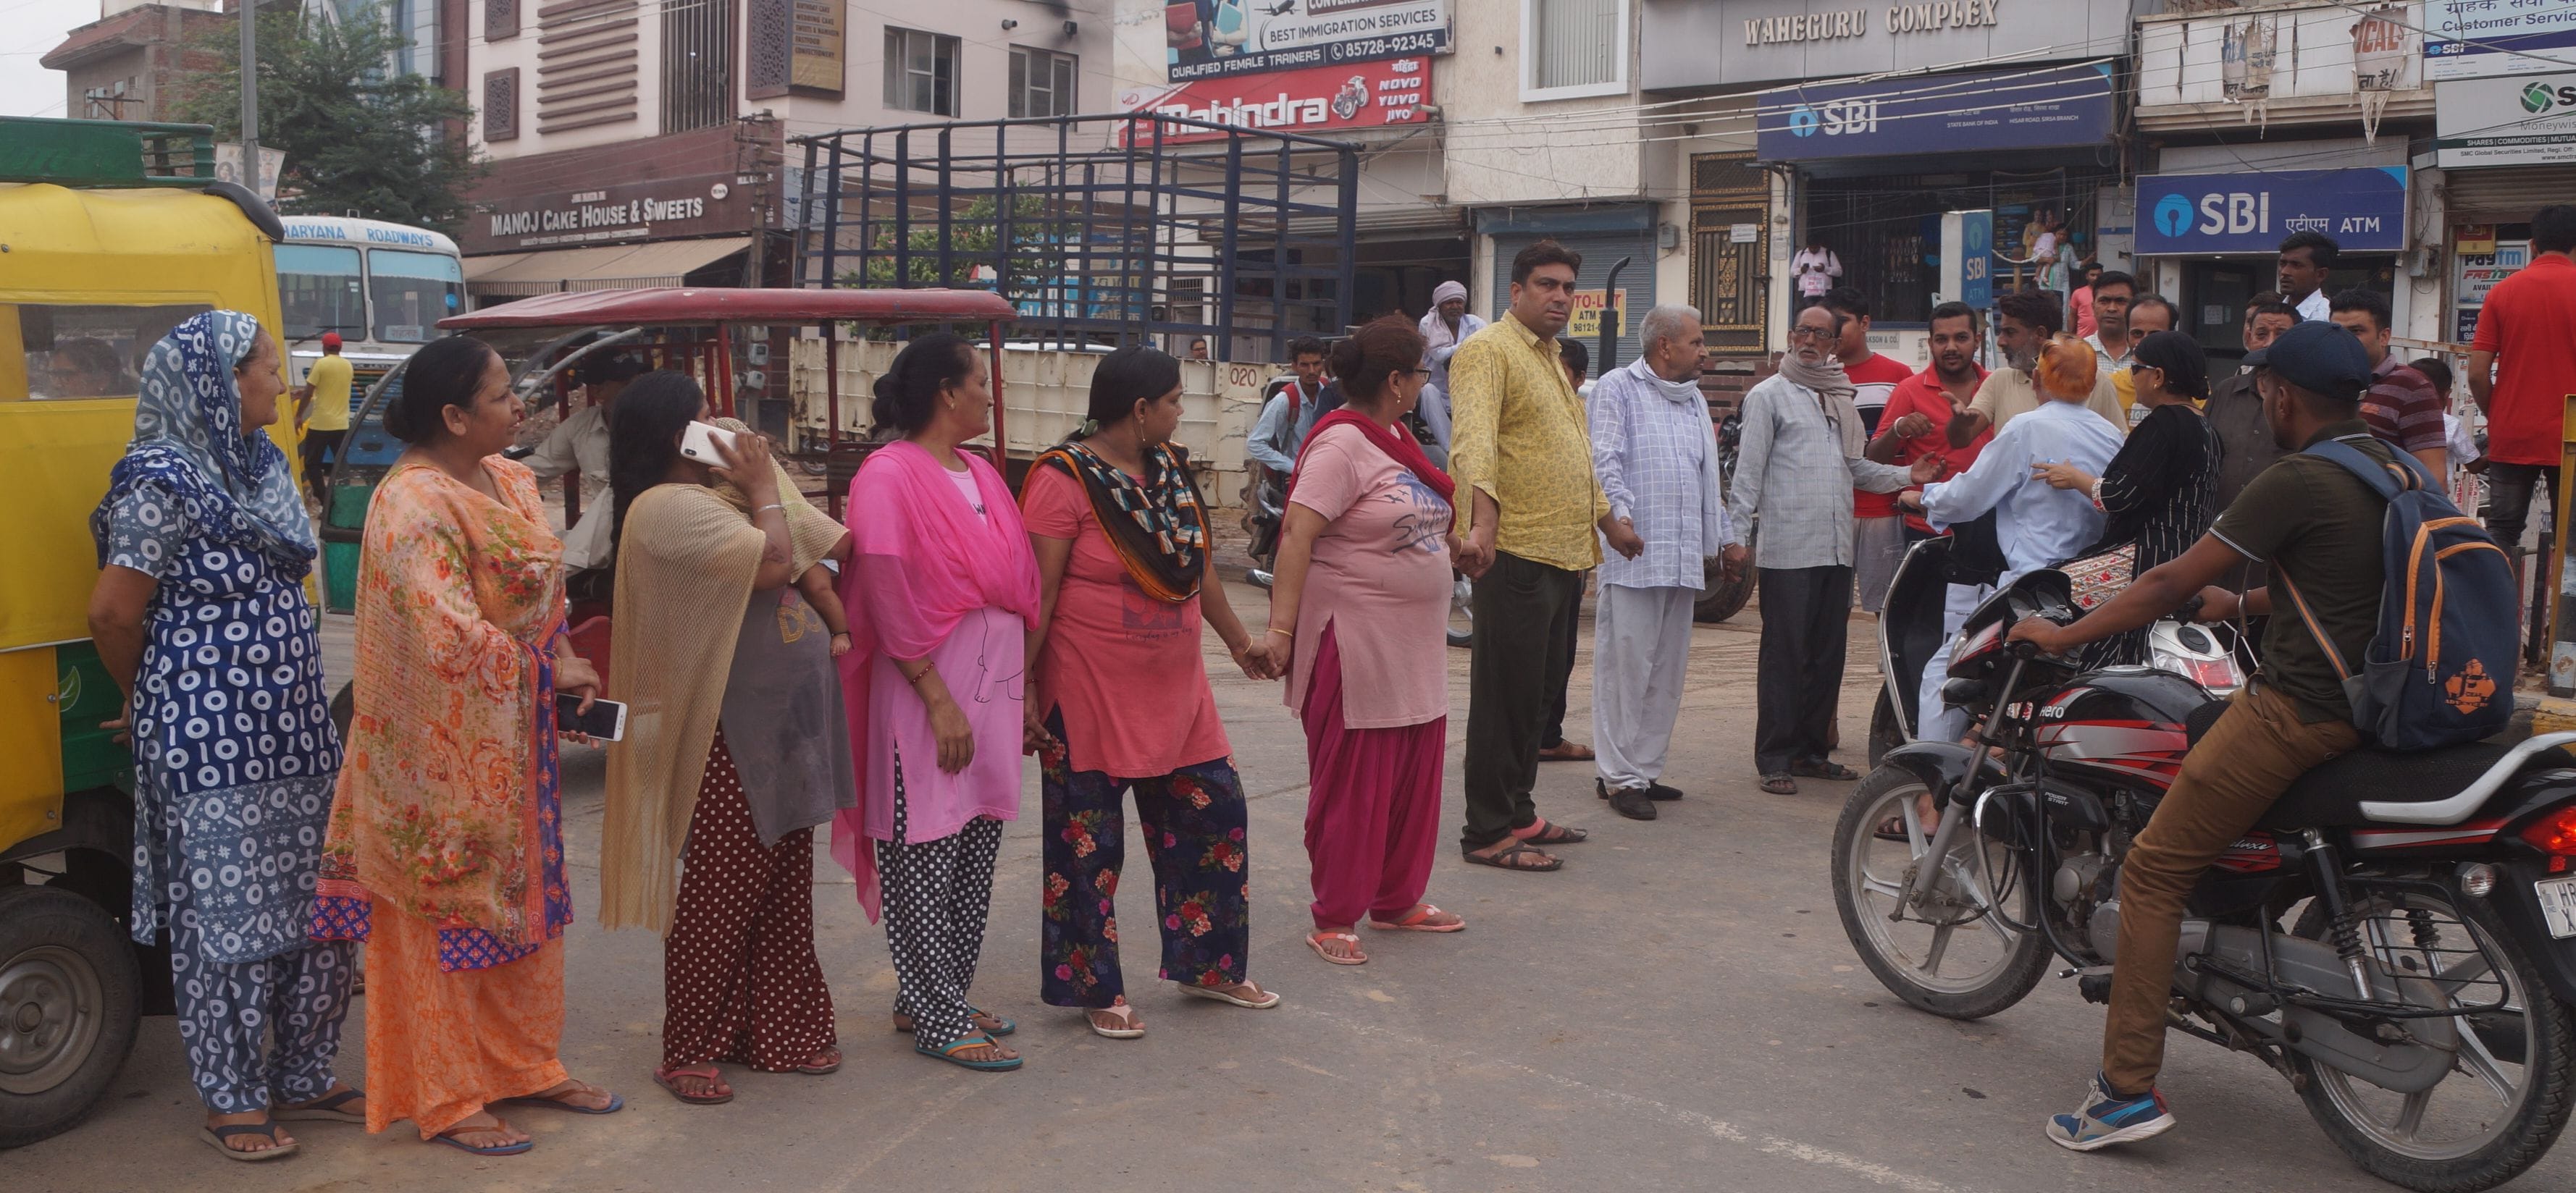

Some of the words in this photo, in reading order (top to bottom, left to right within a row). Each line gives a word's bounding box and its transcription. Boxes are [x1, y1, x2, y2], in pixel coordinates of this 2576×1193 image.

[1270, 28, 1299, 43] BEST
[1299, 17, 1375, 39] IMMIGRATION
[1379, 9, 1436, 28] SERVICES
[1744, 9, 1866, 45] WAHEGURU
[1886, 0, 1997, 34] COMPLEX
[2442, 16, 2520, 31] Customer
[1346, 33, 1435, 57] 85728-92345
[2442, 43, 2464, 54] SBI
[1172, 62, 1221, 78] QUALIFIED
[1224, 56, 1264, 72] FEMALE
[1268, 49, 1321, 67] TRAINERS
[1379, 77, 1422, 91] NOVO
[1379, 93, 1420, 106] YUVO
[1386, 109, 1411, 122] JIVO
[1824, 100, 1877, 136] SBI
[2498, 136, 2547, 145] COMMODITIES
[491, 211, 540, 237] MANOJ
[543, 209, 578, 232] CAKE
[582, 205, 627, 228] HOUSE
[630, 199, 641, 223] &
[643, 198, 703, 222] SWEETS
[2199, 191, 2269, 235] SBI
[2286, 214, 2330, 234] एटीएम
[2340, 216, 2380, 234] ATM
[284, 225, 346, 240] HARYANA
[366, 228, 434, 247] ROADWAYS
[1966, 256, 1986, 281] SBI
[1575, 294, 1621, 309] TO-LT
[1968, 287, 1985, 302] ATM
[1579, 310, 1596, 321] ATM
[1230, 367, 1257, 387] 020
[2039, 705, 2065, 718] Hero
[2045, 791, 2068, 801] POWER
[2047, 797, 2069, 806] START
